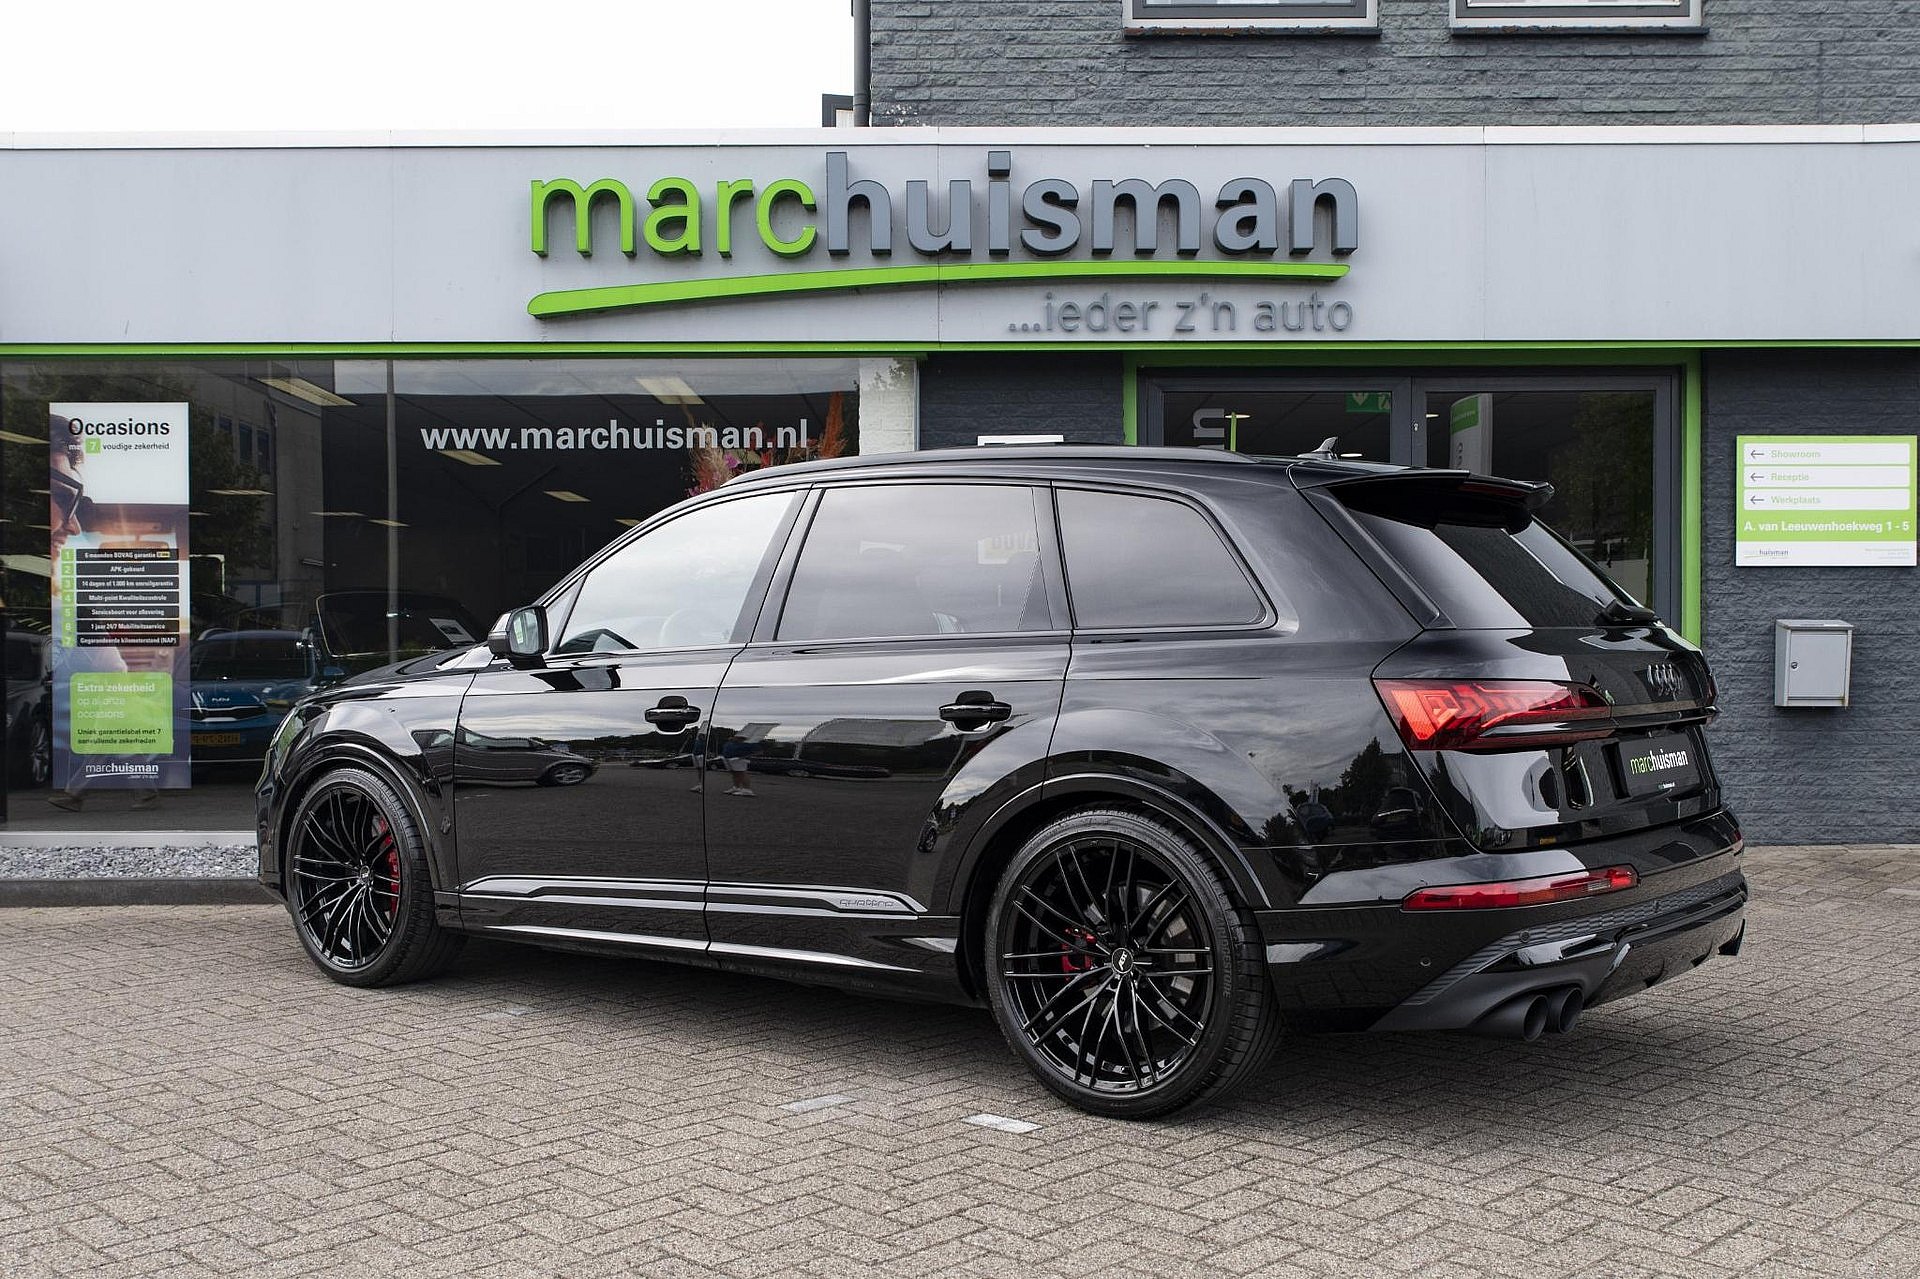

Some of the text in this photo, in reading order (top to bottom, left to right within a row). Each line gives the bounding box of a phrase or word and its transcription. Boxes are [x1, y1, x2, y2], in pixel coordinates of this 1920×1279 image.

[531, 151, 1360, 257] marchuisman
[1008, 292, 1355, 333] ...ieder z'n auto
[69, 418, 170, 436] Occasions
[420, 418, 809, 450] www.marchuisman.nl
[89, 441, 97, 450] 7
[103, 442, 132, 451] voudige
[134, 442, 170, 450] zekerheid
[1770, 449, 1821, 458] Showroom
[1770, 472, 1810, 482] Receptie
[1770, 495, 1821, 505] Werkplaats
[1744, 521, 1755, 532] A.
[1759, 523, 1778, 532] van
[1781, 521, 1883, 534] Leeuwenhoekweg
[1886, 521, 1892, 532] 1
[1902, 521, 1910, 532] 5
[77, 682, 155, 692] Extra zekerheid
[77, 711, 125, 719] occasions
[1630, 749, 1689, 775] marchuisman
[85, 763, 159, 772] marchuisman
